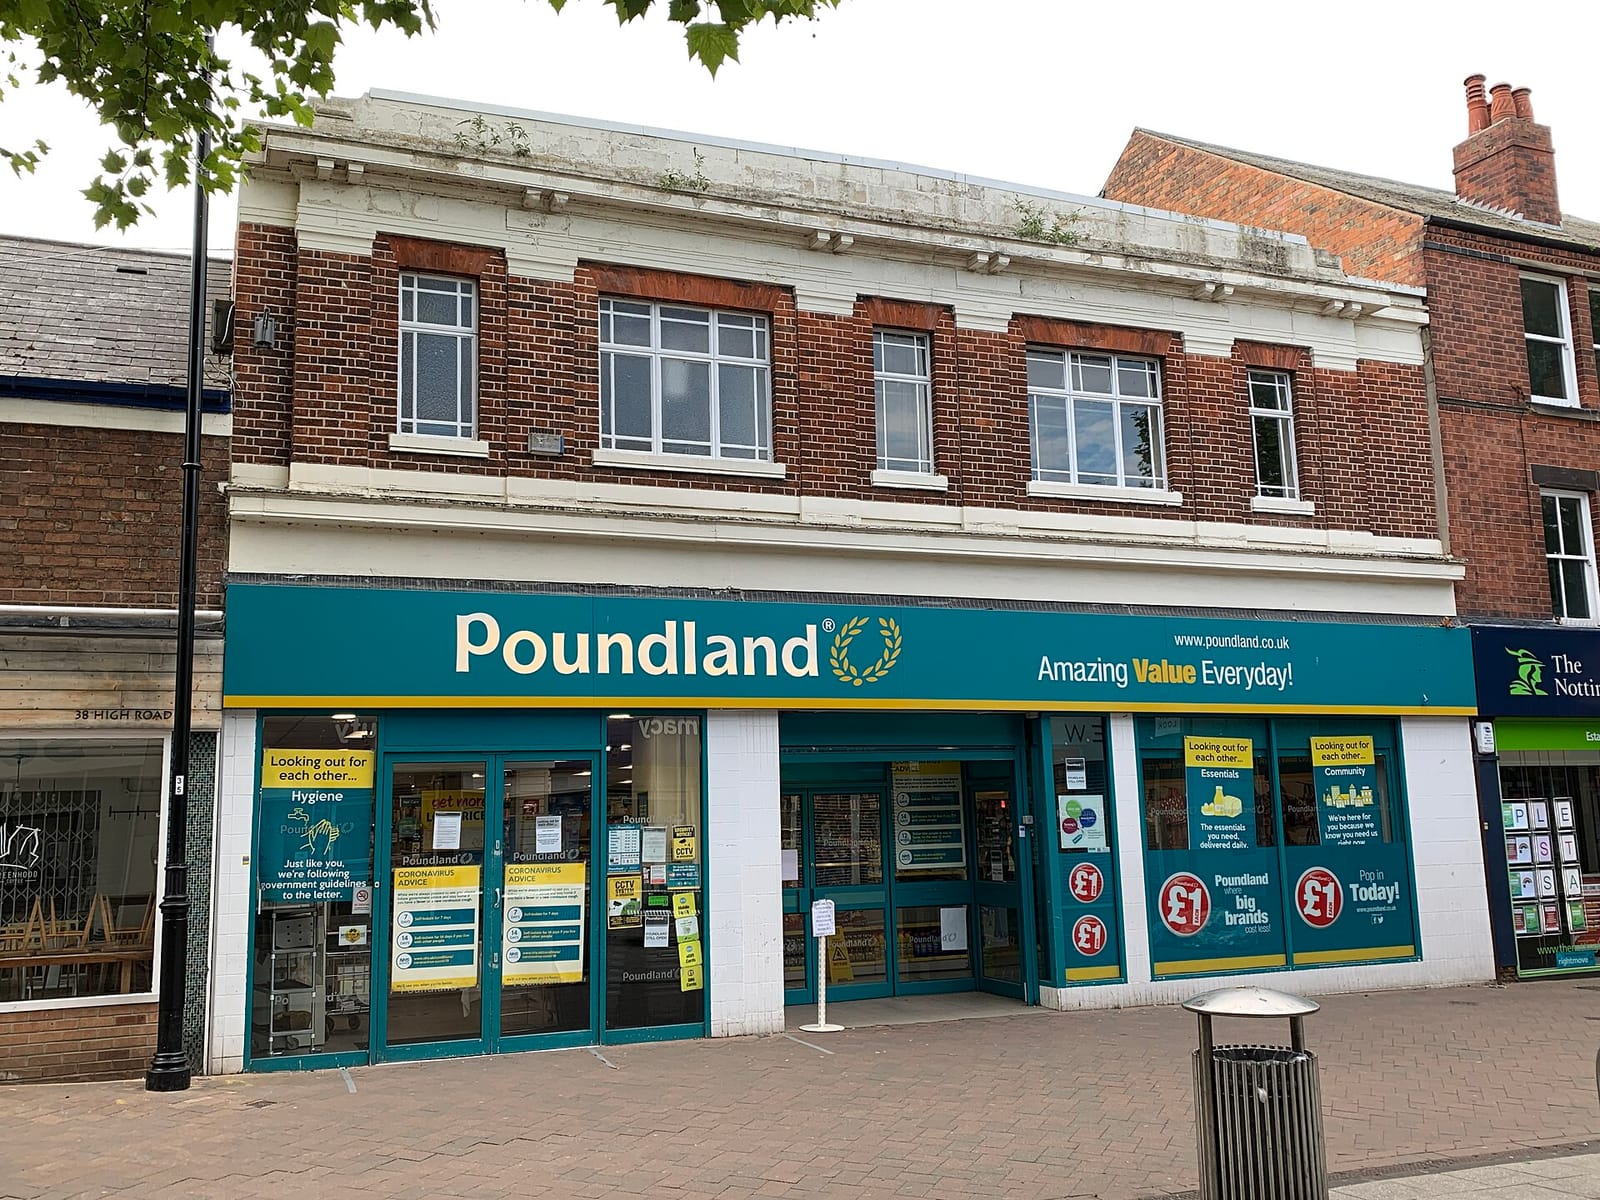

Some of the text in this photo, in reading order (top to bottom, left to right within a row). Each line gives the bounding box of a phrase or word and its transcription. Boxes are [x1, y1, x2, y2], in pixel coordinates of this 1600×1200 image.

[456, 612, 820, 677] Poundland
[1174, 634, 1290, 649] www.poundland.co.uk
[1551, 653, 1582, 674] The
[1038, 656, 1294, 691] Amazing Value Everyday!
[75, 710, 173, 720] 38 HIGH ROAD
[1189, 742, 1248, 753] Looking out for
[1315, 741, 1344, 752] Looking
[1359, 740, 1369, 749] for
[1195, 753, 1214, 762] each
[1321, 752, 1339, 760] each
[271, 756, 367, 769] Looking out for
[280, 770, 357, 781] each other...
[1201, 769, 1239, 779] Essentials
[1324, 766, 1366, 777] Community
[292, 790, 343, 804] Hygiene
[432, 795, 454, 809] get
[1328, 814, 1346, 822] We're
[1347, 813, 1361, 821] here
[1200, 823, 1246, 831] The essentials
[1327, 824, 1339, 832] you
[1340, 822, 1364, 830] because
[1207, 832, 1240, 841] you need,
[1325, 831, 1341, 839] know
[1342, 832, 1353, 840] you
[1354, 830, 1370, 838] need
[1200, 841, 1230, 849] delivered
[513, 849, 566, 862] Poundland
[676, 848, 694, 856] CCTV
[284, 859, 345, 869] Just like you,
[402, 854, 459, 866] Poundland
[278, 869, 350, 879] we're following
[398, 869, 455, 878] CORONAVIRUS
[508, 866, 561, 875] CORONAVIRUS
[1360, 869, 1384, 882] Pop in
[261, 879, 366, 891] government guidelines
[615, 880, 635, 888] CCTV
[1074, 869, 1098, 897] £1
[1214, 873, 1269, 887] Poundland
[283, 891, 343, 899] to the letter.
[1224, 887, 1242, 895] where
[1349, 881, 1400, 904] Today!
[1235, 895, 1256, 912] big
[1303, 879, 1335, 918] £1
[1168, 885, 1202, 926] £1
[1225, 909, 1269, 926] brands
[1245, 926, 1257, 934] cost
[1078, 923, 1101, 949] £1
[1558, 956, 1589, 967] rightmove
[622, 968, 673, 981] Poundland
